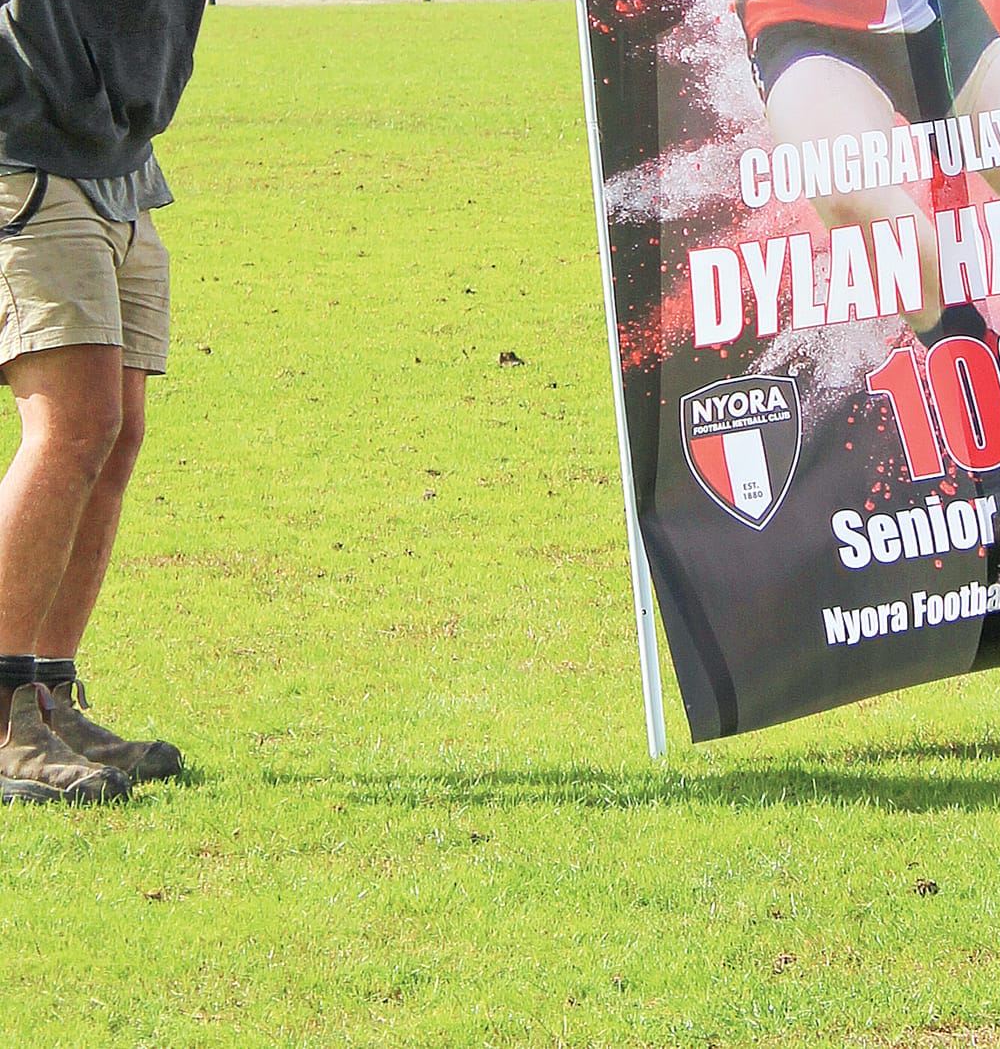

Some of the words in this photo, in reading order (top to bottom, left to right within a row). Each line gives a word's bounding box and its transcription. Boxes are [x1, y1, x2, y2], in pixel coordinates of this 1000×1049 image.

[688, 214, 924, 349] DYLAN
[692, 386, 788, 424] NYORA
[693, 421, 732, 436] FOOTBALL
[732, 416, 767, 428] NETBALL
[768, 411, 791, 422] CLUB
[743, 481, 760, 491] EST.
[832, 494, 997, 570] Senior
[822, 601, 908, 646] Nyora
